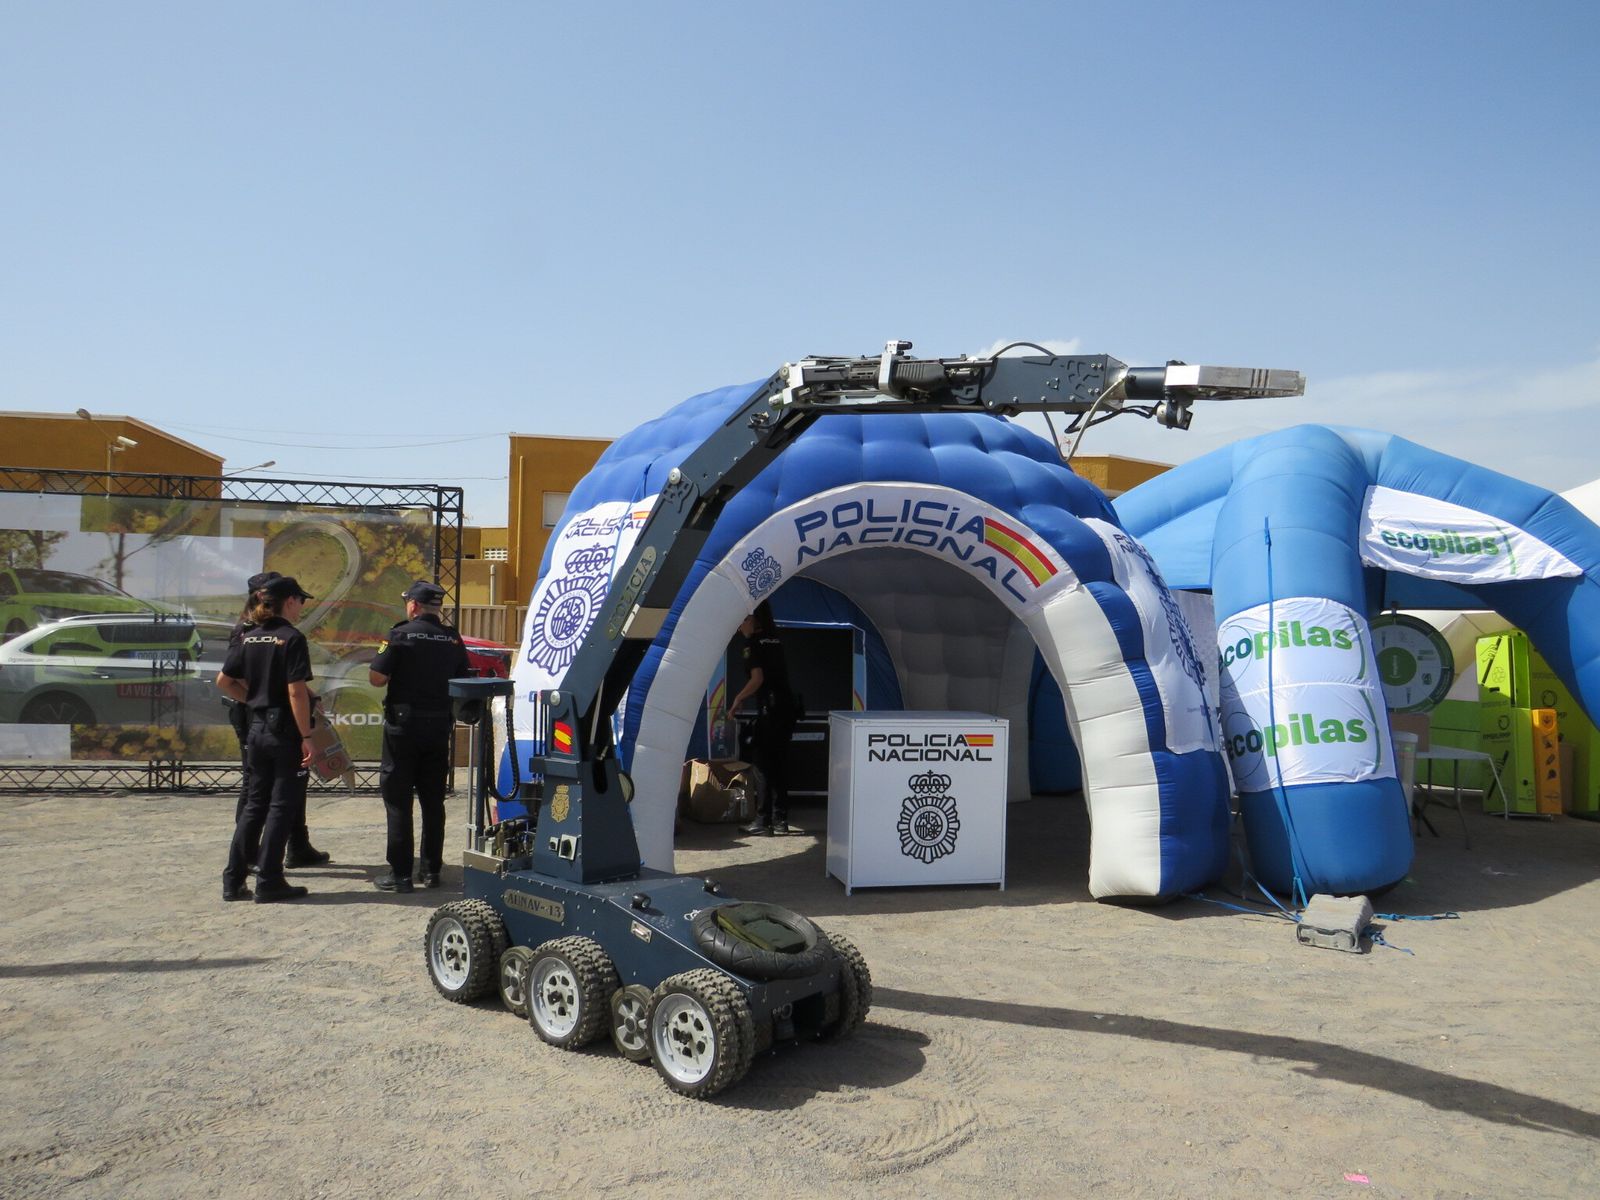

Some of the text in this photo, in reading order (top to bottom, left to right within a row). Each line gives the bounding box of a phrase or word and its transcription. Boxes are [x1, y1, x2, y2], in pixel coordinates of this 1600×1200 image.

[565, 520, 643, 539] NACIONAL
[1381, 528, 1500, 558] ecopilas
[797, 527, 1026, 603] NACIONAL
[323, 710, 386, 726] ŠKOD
[868, 749, 993, 762] NACIONAL
